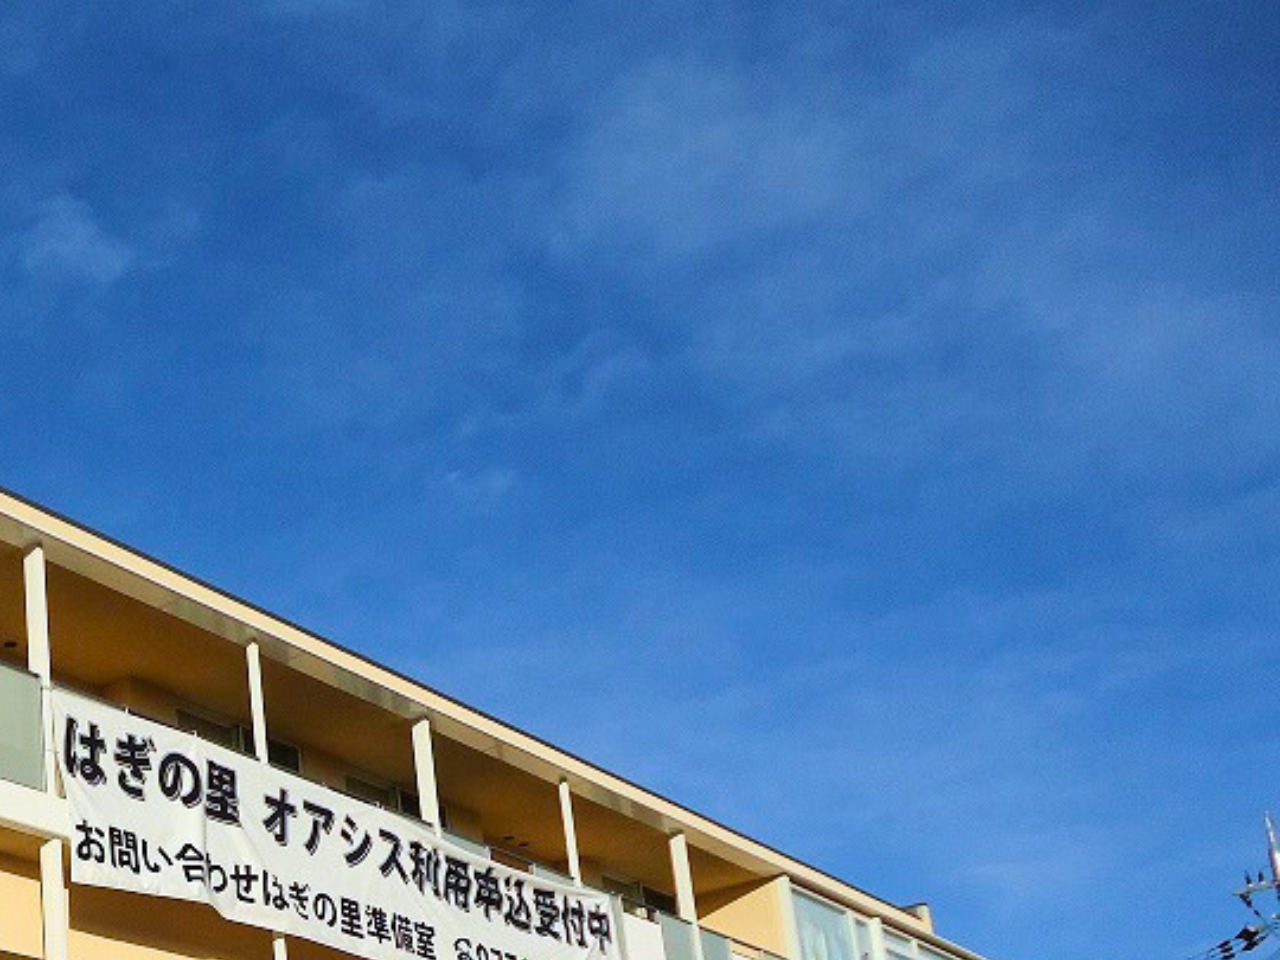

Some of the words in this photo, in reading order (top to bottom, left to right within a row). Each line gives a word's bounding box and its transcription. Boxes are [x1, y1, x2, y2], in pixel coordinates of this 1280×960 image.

[64, 716, 242, 828] はぎの里
[262, 787, 613, 956] オアシス利用申込受付中
